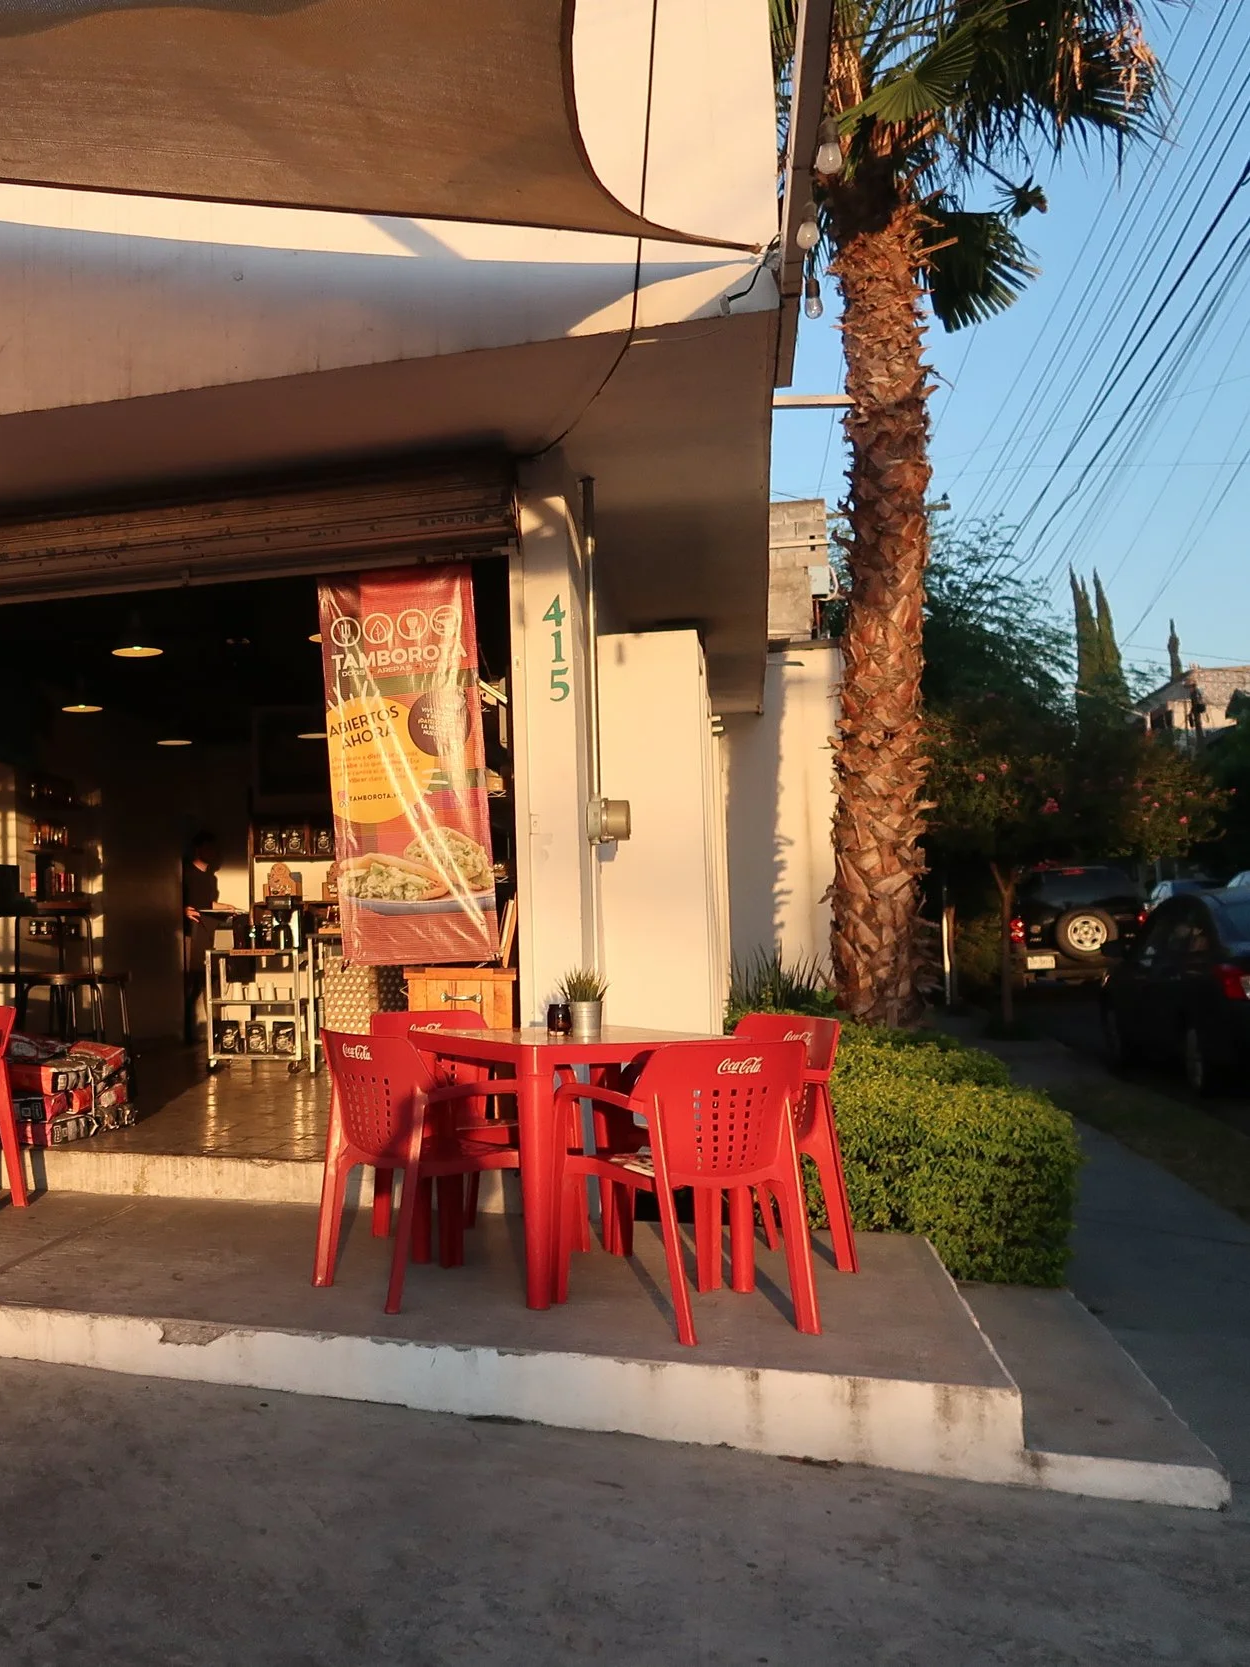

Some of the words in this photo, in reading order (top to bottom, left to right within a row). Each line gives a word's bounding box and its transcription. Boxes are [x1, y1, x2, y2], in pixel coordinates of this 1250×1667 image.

[542, 594, 571, 702] 415
[330, 705, 399, 738] ABIERTOS
[342, 1042, 373, 1061] Coca-Cola
[717, 1055, 764, 1076] Coca-Cola
